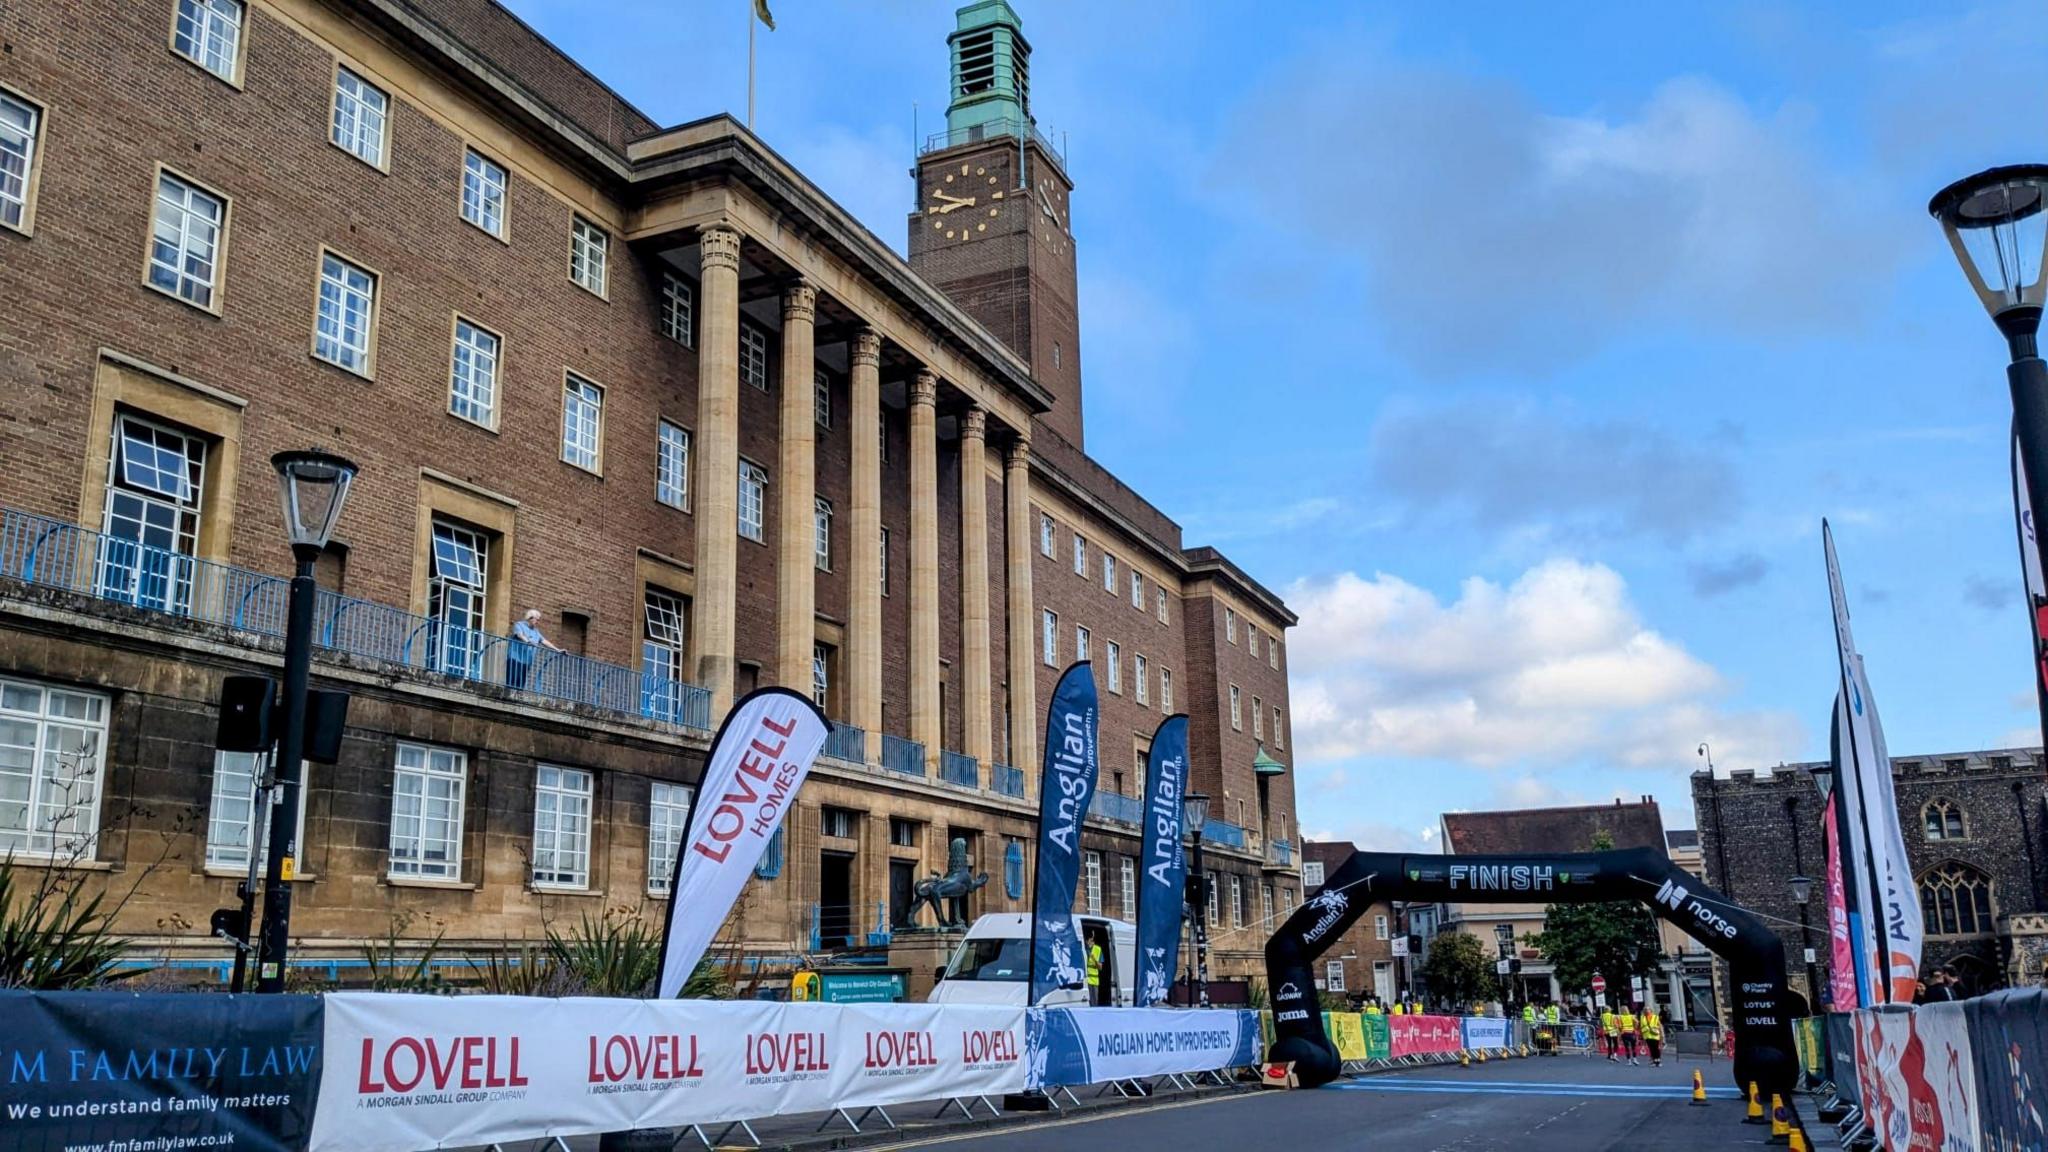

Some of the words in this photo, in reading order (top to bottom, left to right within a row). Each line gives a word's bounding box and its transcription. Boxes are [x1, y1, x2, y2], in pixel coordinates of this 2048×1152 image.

[1084, 707, 1095, 778] improvements
[693, 717, 797, 864] LOVELL
[750, 762, 799, 837] HOMES
[1049, 712, 1087, 855] Anglian
[1148, 759, 1179, 887] Anglian
[1449, 864, 1552, 890] FINISH
[1302, 910, 1340, 944] Anglian
[1688, 901, 1737, 938] norse
[1746, 1016, 1778, 1025] LOVELL
[588, 1034, 704, 1083] LOVELL
[746, 1032, 829, 1075] LOVELL
[865, 1030, 937, 1068] LOVELL
[963, 1030, 1018, 1063] LOVELL
[1097, 1033, 1144, 1057] ANGLIAN
[1146, 1031, 1174, 1054] HOME
[1174, 1030, 1231, 1052] IMPROVEMENTS
[0, 1049, 49, 1084] M
[68, 1047, 227, 1082] FAMILY
[240, 1045, 316, 1077] LAW
[358, 1036, 529, 1094] LOVELL
[8, 1104, 41, 1119] We
[50, 1098, 161, 1118] understand
[168, 1095, 219, 1112] family
[223, 1094, 290, 1108] matters
[357, 1099, 366, 1108] A
[366, 1095, 412, 1109] MORGAN
[414, 1092, 453, 1105] SINDALL
[455, 1091, 488, 1103] GROUP
[488, 1089, 528, 1101] COMPANY
[592, 1085, 623, 1095] MORGAN
[622, 1083, 649, 1093] SINDALL
[649, 1081, 671, 1091] GROUP
[64, 1131, 234, 1152] www.fmfamilylaw.co.uk
